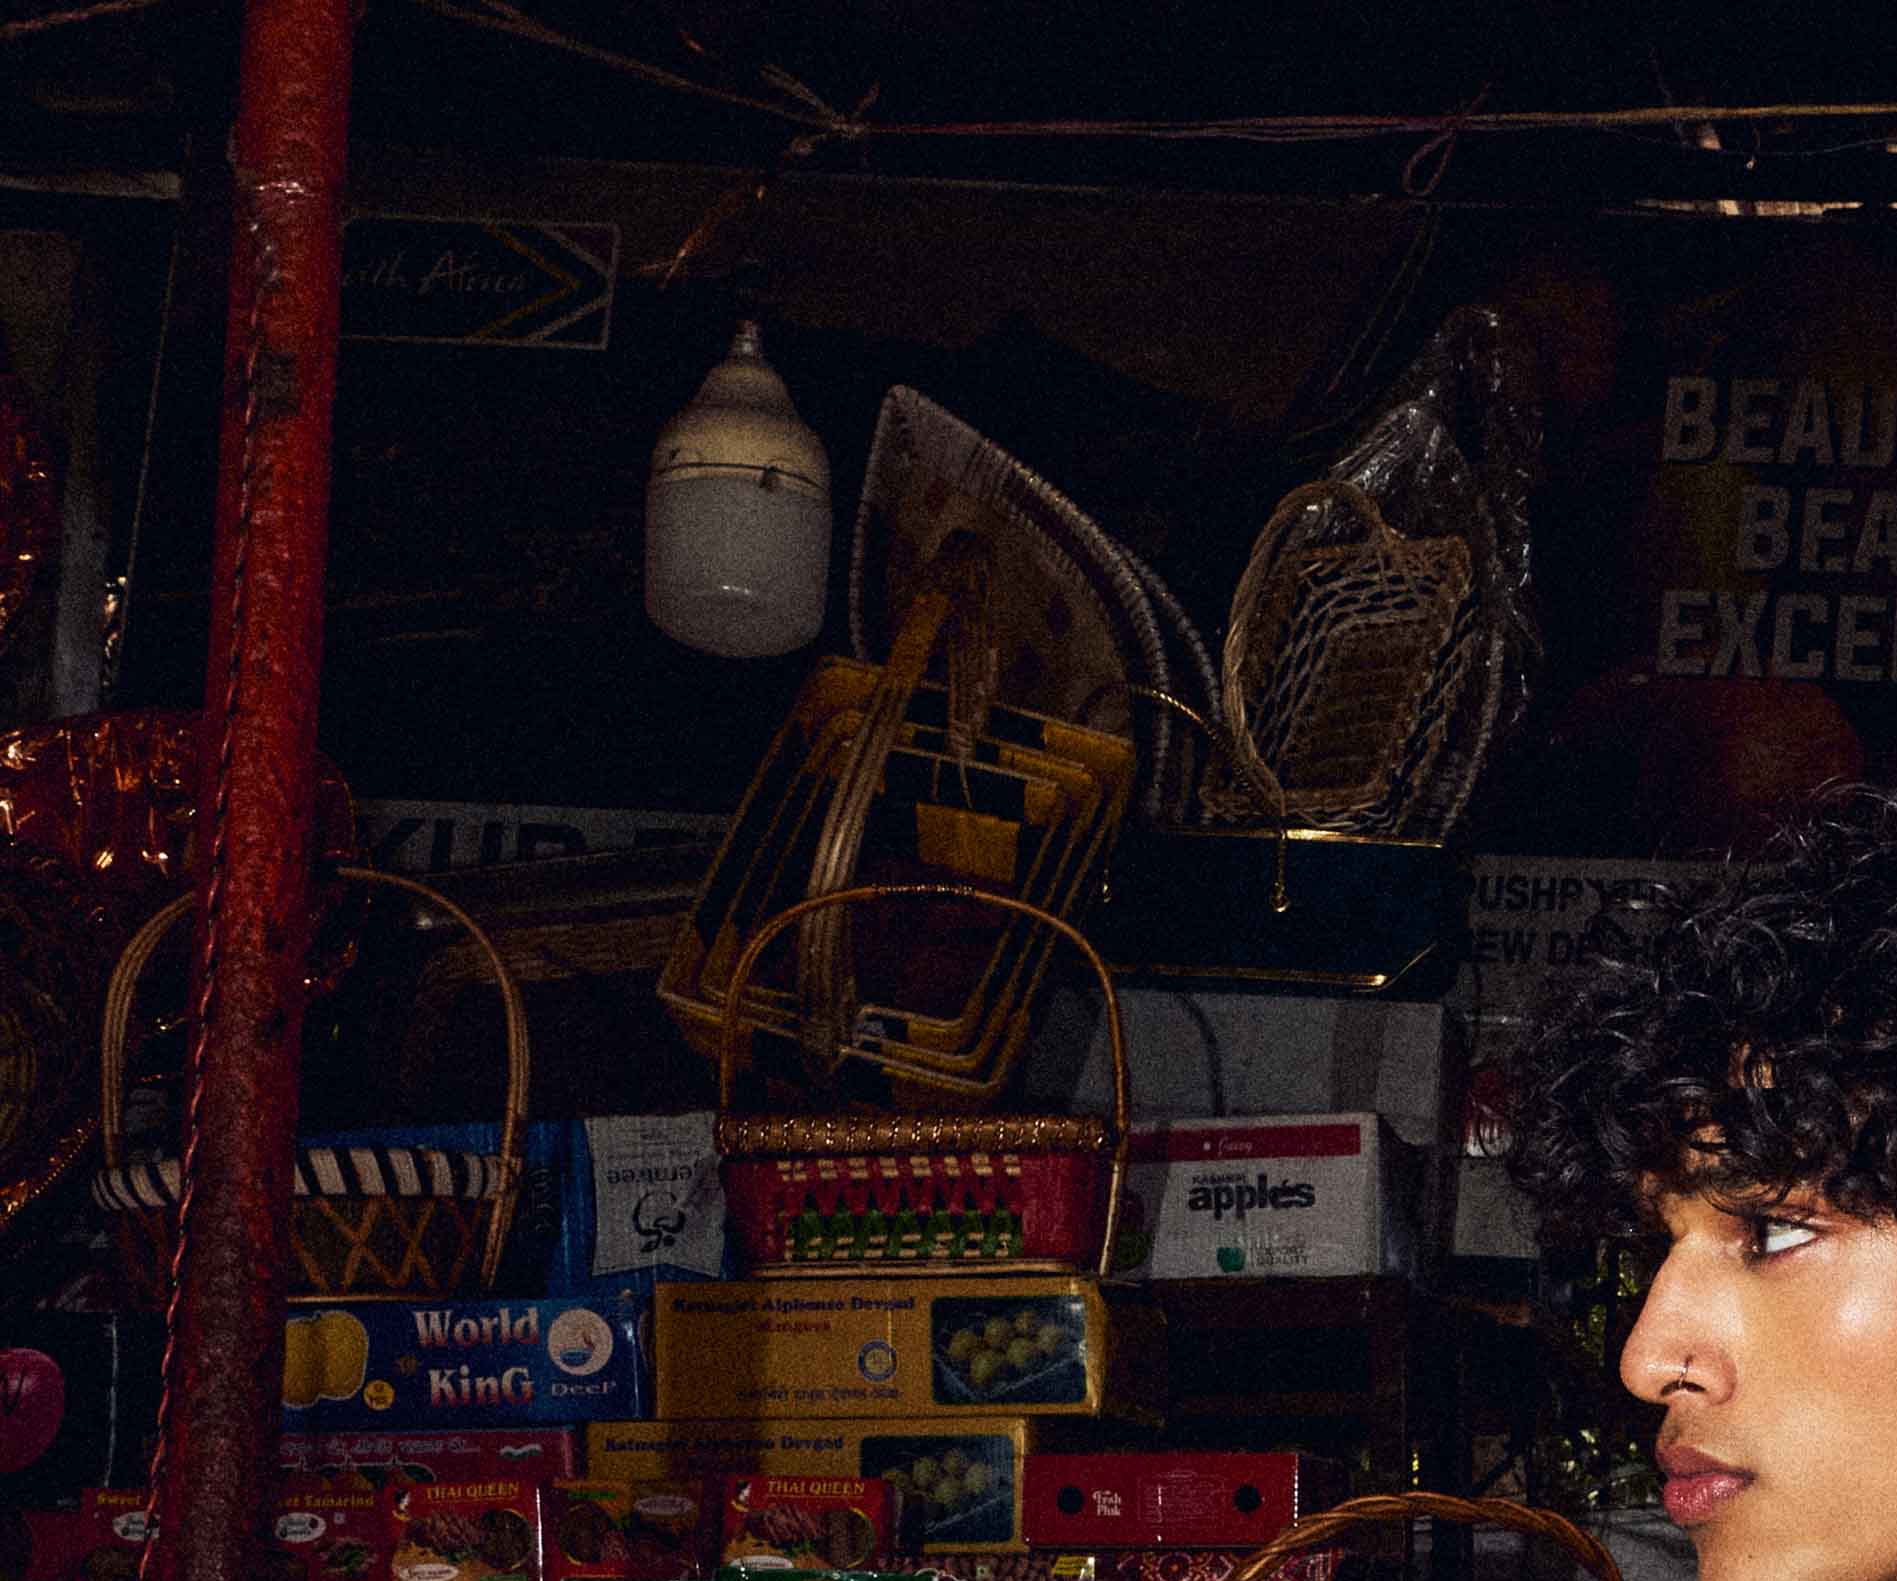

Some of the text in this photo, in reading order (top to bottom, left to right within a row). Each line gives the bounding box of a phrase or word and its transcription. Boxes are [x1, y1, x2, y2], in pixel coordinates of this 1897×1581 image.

[1470, 874, 1584, 912] USHP
[1472, 929, 1536, 962] EW
[1188, 1173, 1315, 1220] apples
[413, 1307, 540, 1348] World
[425, 1483, 520, 1501] THAI QUEEN
[767, 1481, 866, 1496] THAI QUEEN
